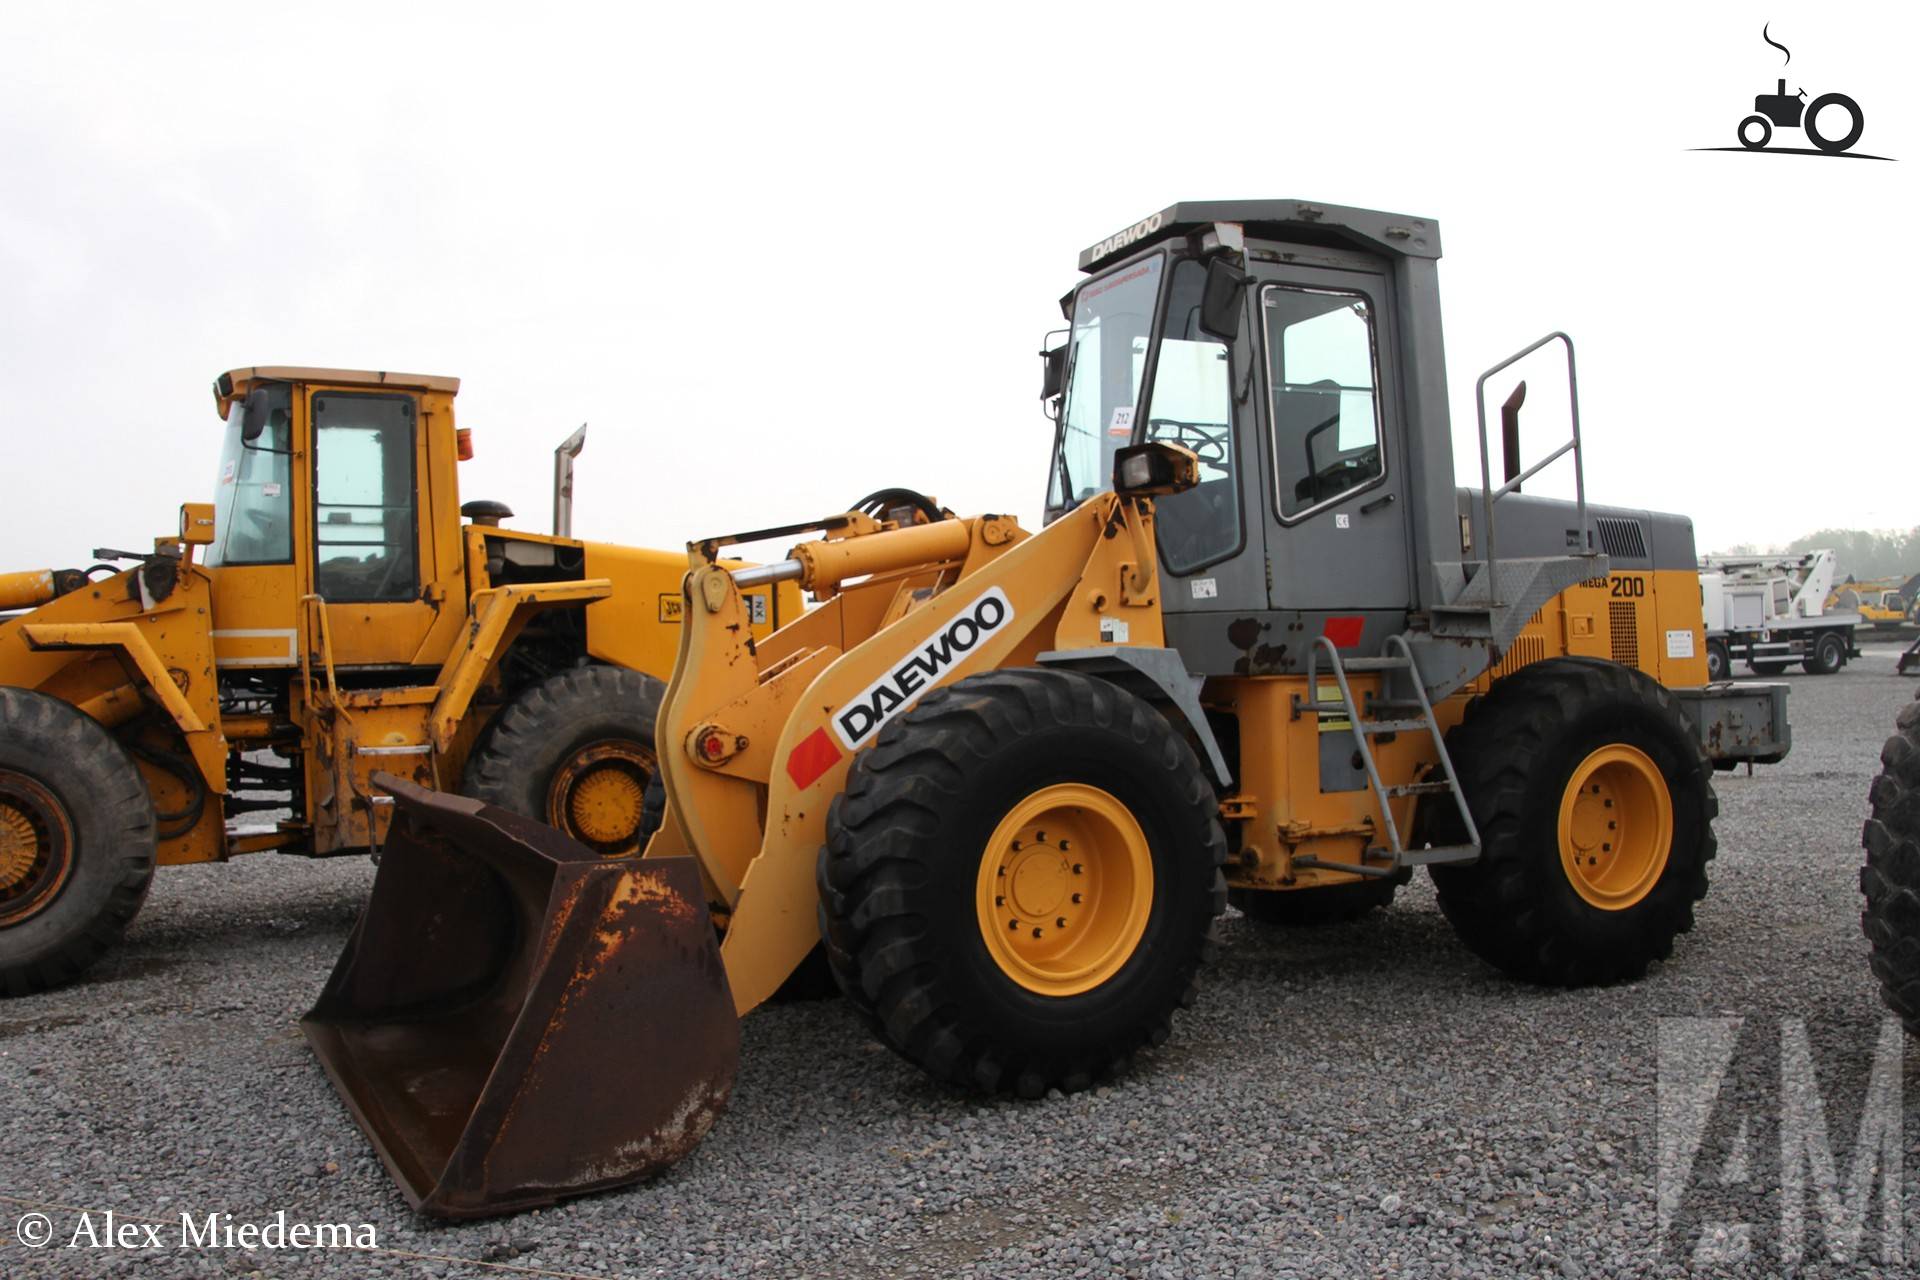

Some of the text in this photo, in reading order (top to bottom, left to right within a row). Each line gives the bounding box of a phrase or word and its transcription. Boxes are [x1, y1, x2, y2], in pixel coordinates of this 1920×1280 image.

[1092, 212, 1162, 262] DAEWOO
[1611, 576, 1645, 598] 200
[839, 596, 1005, 743] DAEWOO
